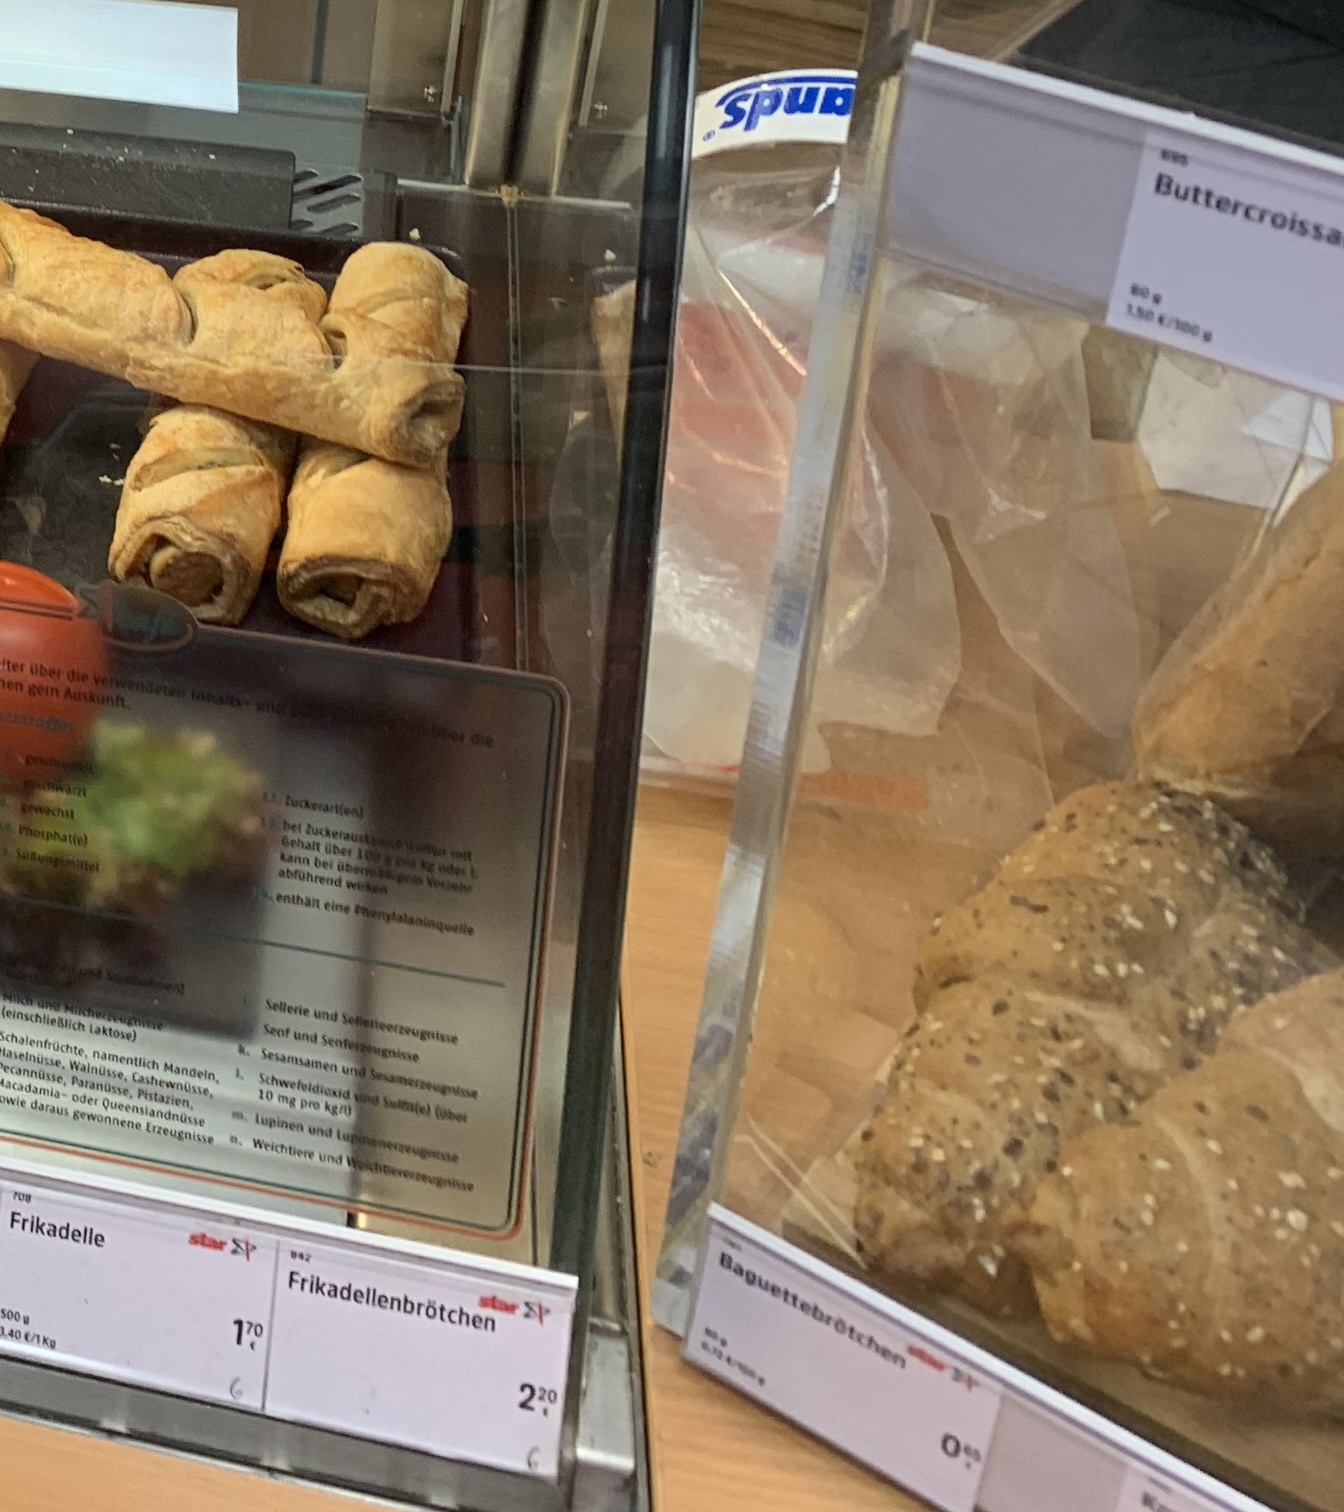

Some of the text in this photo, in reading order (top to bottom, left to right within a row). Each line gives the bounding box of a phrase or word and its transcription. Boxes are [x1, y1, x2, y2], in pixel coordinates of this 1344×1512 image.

[1154, 171, 1344, 249] Buttercroissa
[66, 666, 89, 684] die
[62, 685, 132, 712] Auskunft.
[89, 1023, 138, 1043] Laktose)
[0, 1030, 220, 1085] Schalenfrüchte, namentlich Mandeln,
[68, 1058, 128, 1083] Walnüsse,
[131, 1071, 214, 1099] Cashewnüsse,
[71, 1075, 134, 1100] Paranüsse,
[136, 1088, 194, 1111] Pistazien,
[71, 1092, 99, 1106] oder
[257, 1088, 321, 1113] 10 mg pro
[72, 1109, 215, 1144] gewonnene Erzeugnisse
[9, 1210, 106, 1249] Frikadelle
[287, 1270, 497, 1333] Frikadellenbrötchen
